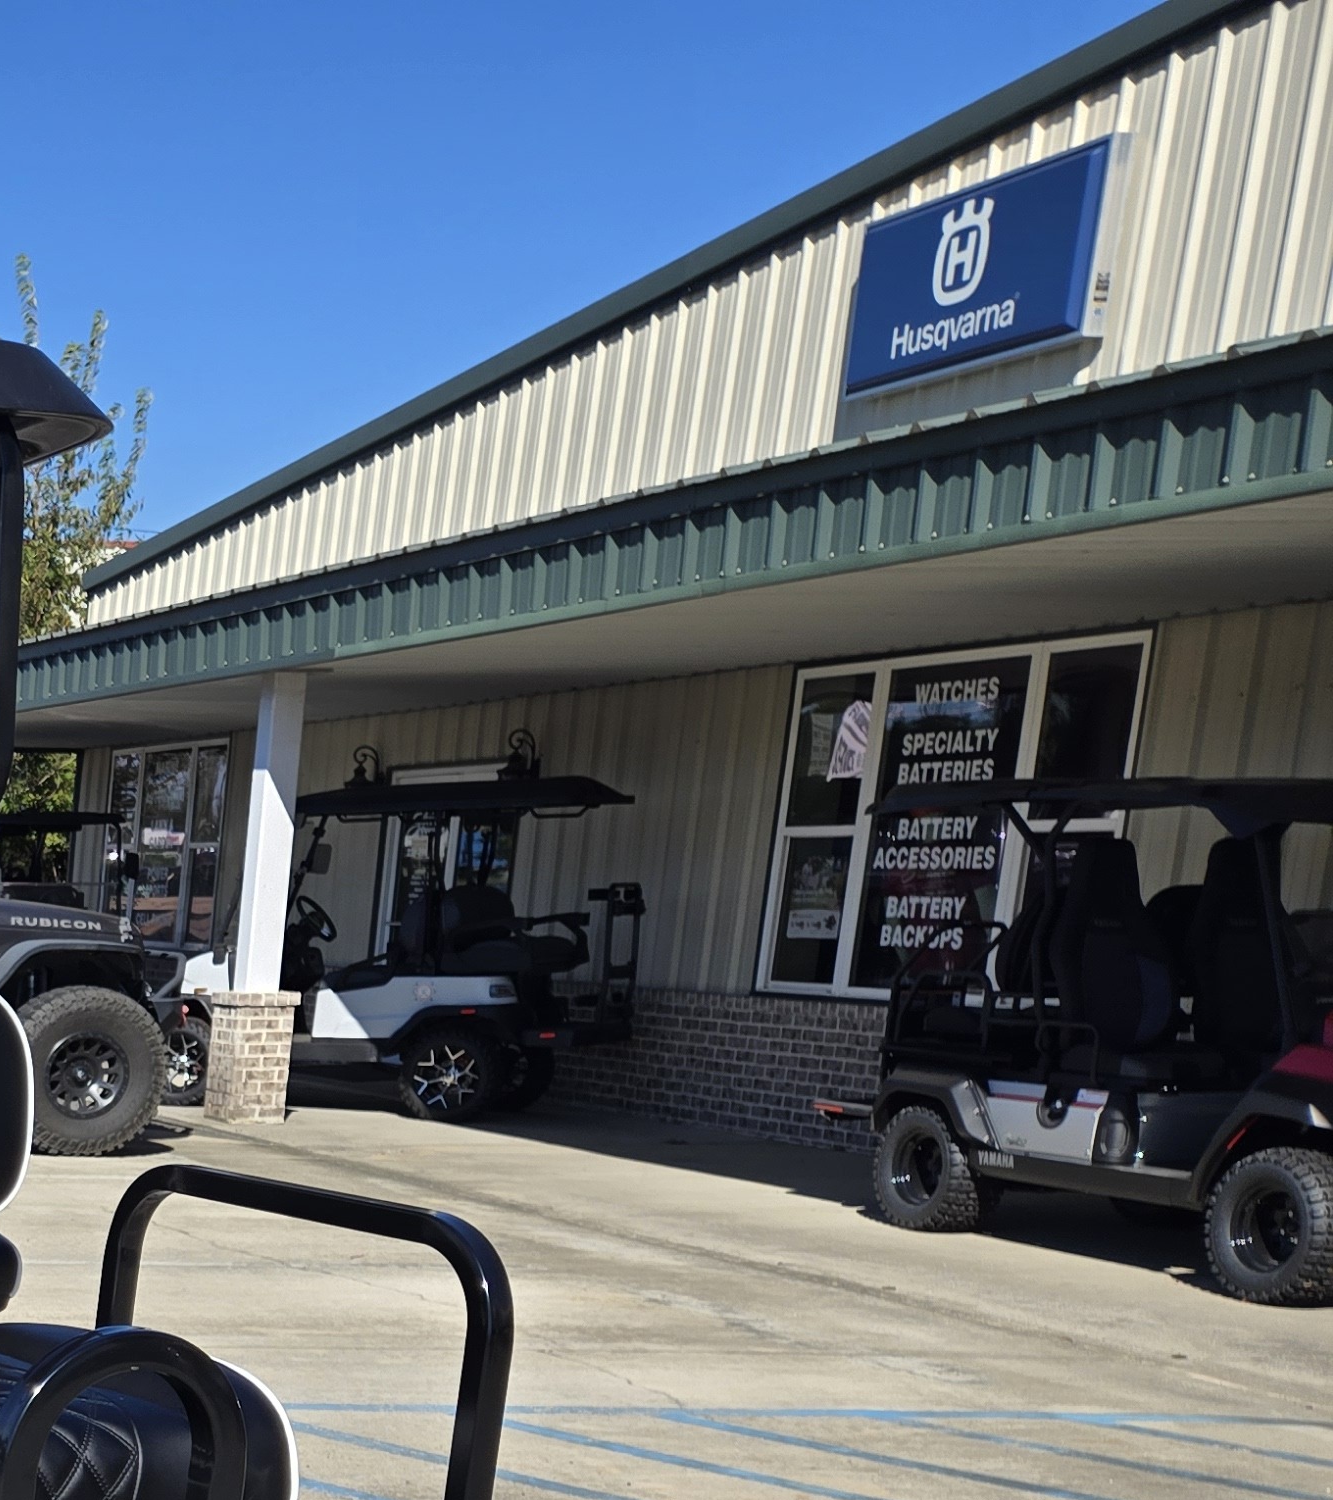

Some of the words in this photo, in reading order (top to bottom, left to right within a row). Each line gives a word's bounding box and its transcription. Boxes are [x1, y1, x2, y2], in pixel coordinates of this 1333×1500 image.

[890, 298, 1017, 360] Husqvarna
[915, 676, 1000, 705] WATCHES
[901, 727, 1000, 756] SPECIALTY
[897, 757, 995, 785] BATTERIES
[896, 815, 978, 841] BATTERY
[873, 845, 996, 870] ACCESSORIES
[885, 895, 967, 920] BATTERY
[10, 916, 102, 931] RUBICON
[978, 1149, 1015, 1169] YAMAHA
